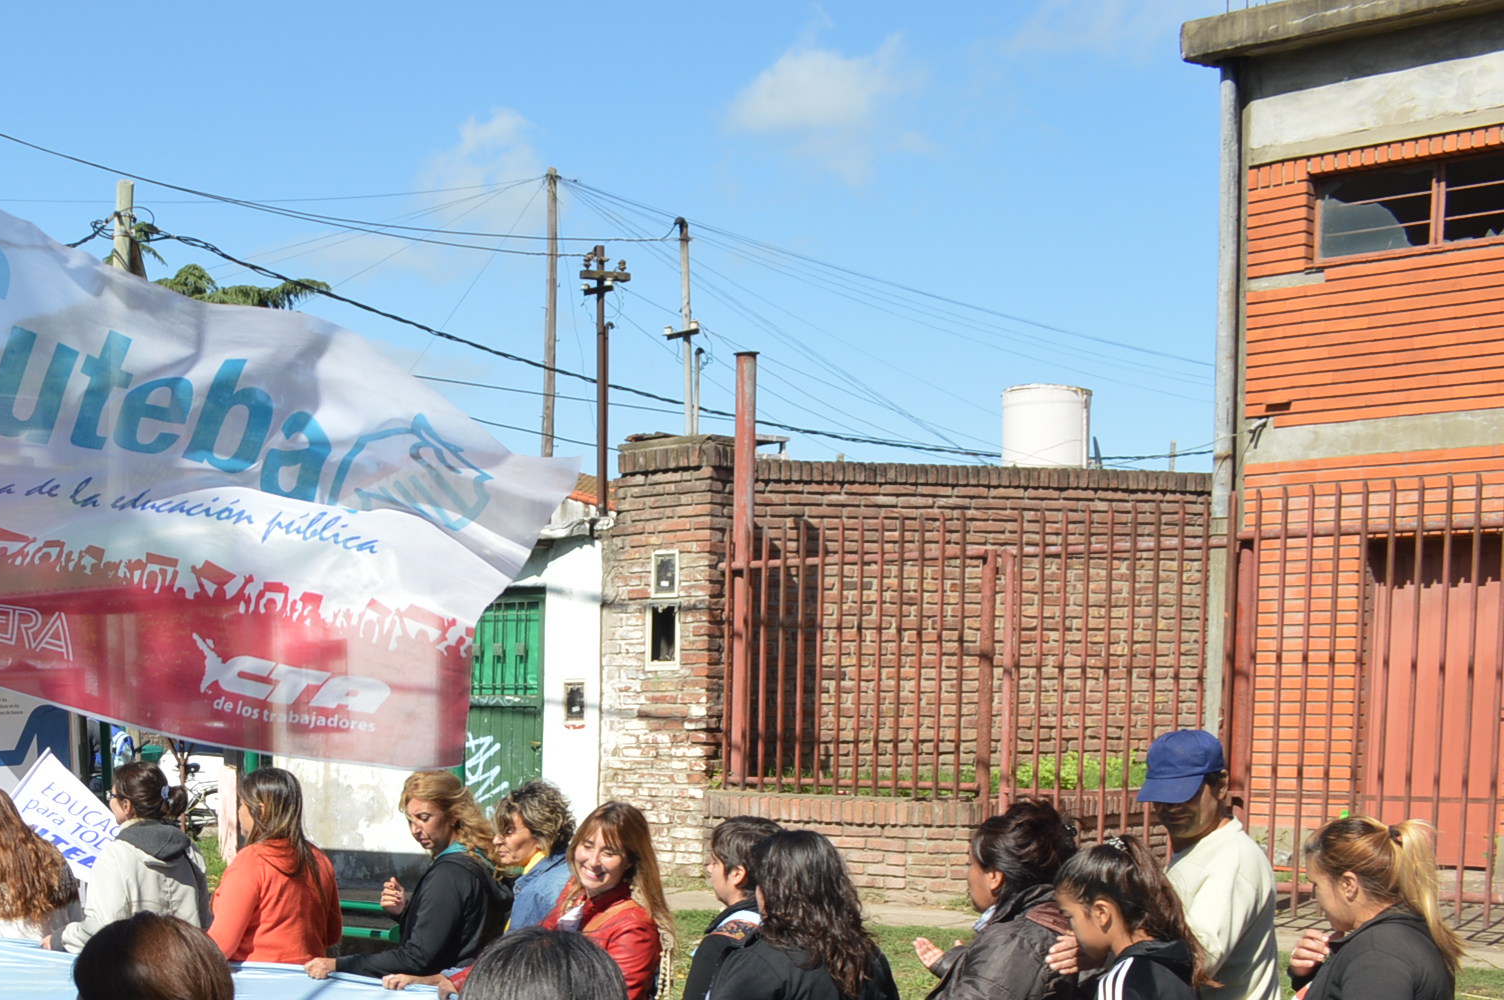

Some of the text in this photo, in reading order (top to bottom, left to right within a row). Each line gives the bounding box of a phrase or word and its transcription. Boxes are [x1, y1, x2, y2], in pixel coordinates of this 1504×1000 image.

[25, 477, 59, 498] de
[70, 476, 100, 509] la
[111, 489, 253, 526] educación
[261, 510, 378, 554] pública
[218, 655, 392, 714] CTA
[213, 696, 377, 733] de los trabajadores
[21, 799, 65, 826] para
